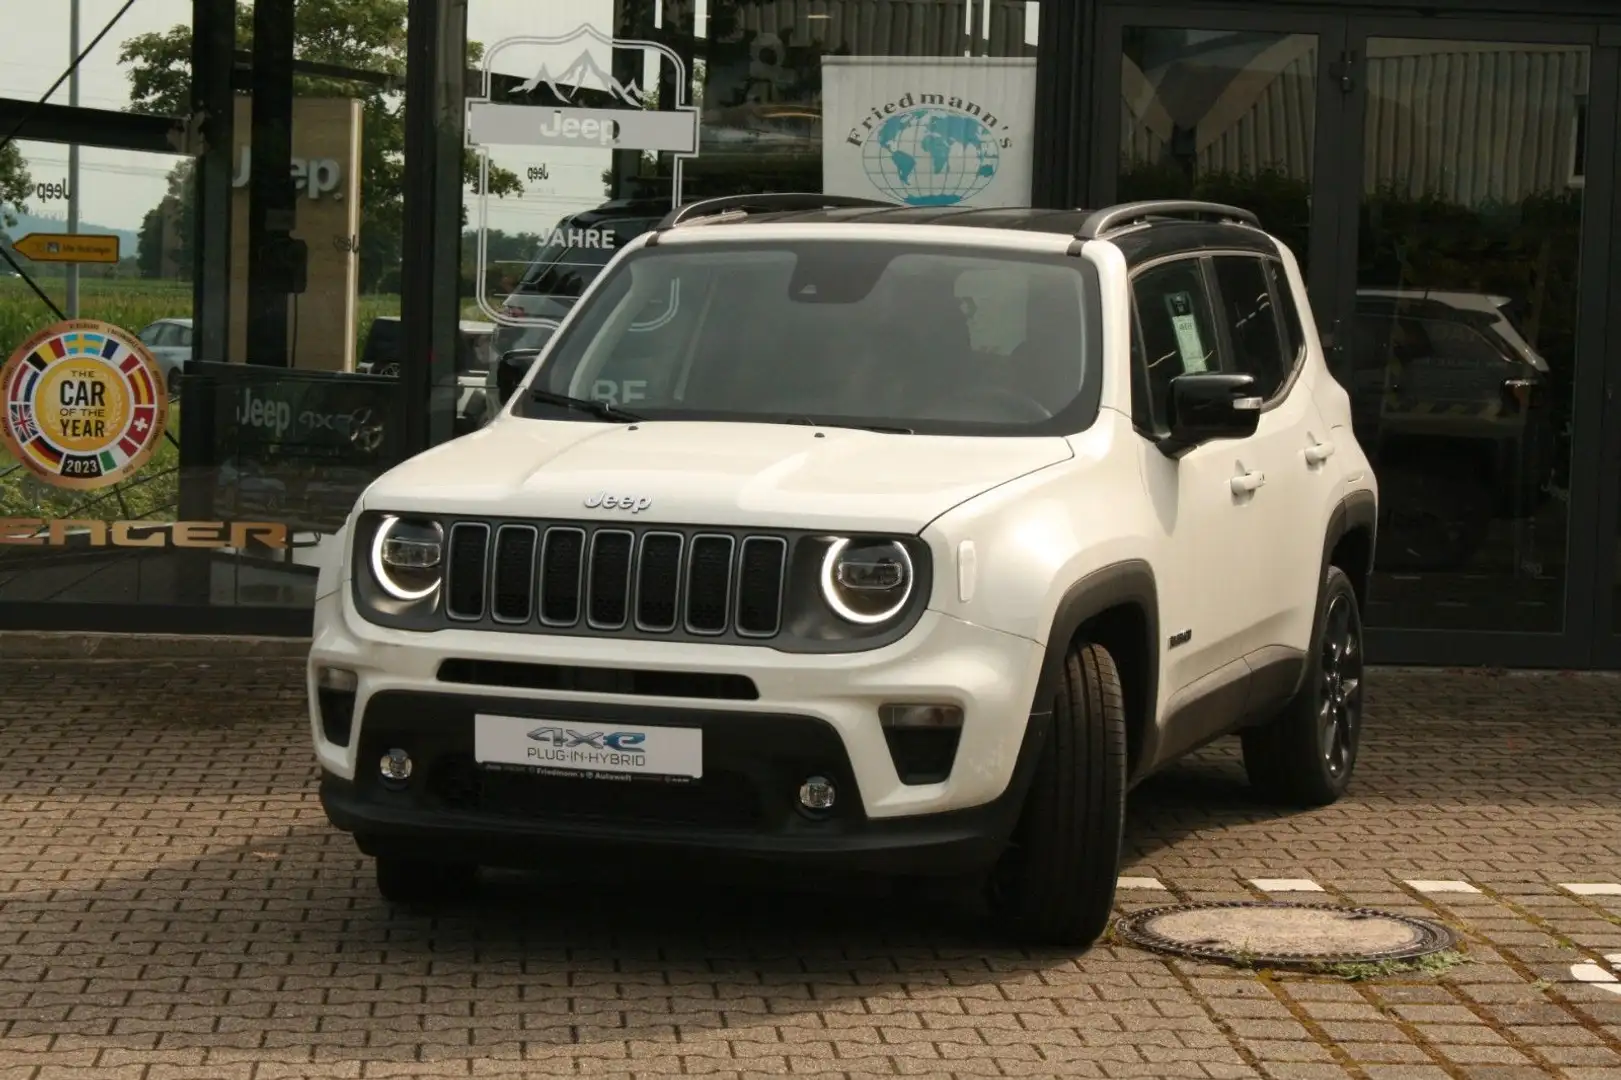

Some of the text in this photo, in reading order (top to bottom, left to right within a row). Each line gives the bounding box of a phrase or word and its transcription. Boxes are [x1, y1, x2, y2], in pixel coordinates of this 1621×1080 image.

[540, 110, 620, 146] Jeep
[846, 92, 1013, 149] Friedmann's
[232, 145, 339, 199] Jep
[536, 228, 616, 249] JAHRE
[71, 370, 95, 378] THE
[60, 380, 105, 406] CAR
[60, 408, 105, 418] OF THE
[241, 387, 291, 438] Jeep
[60, 419, 105, 437] YEAR
[65, 459, 98, 474] 2023
[584, 487, 652, 514] Jeep
